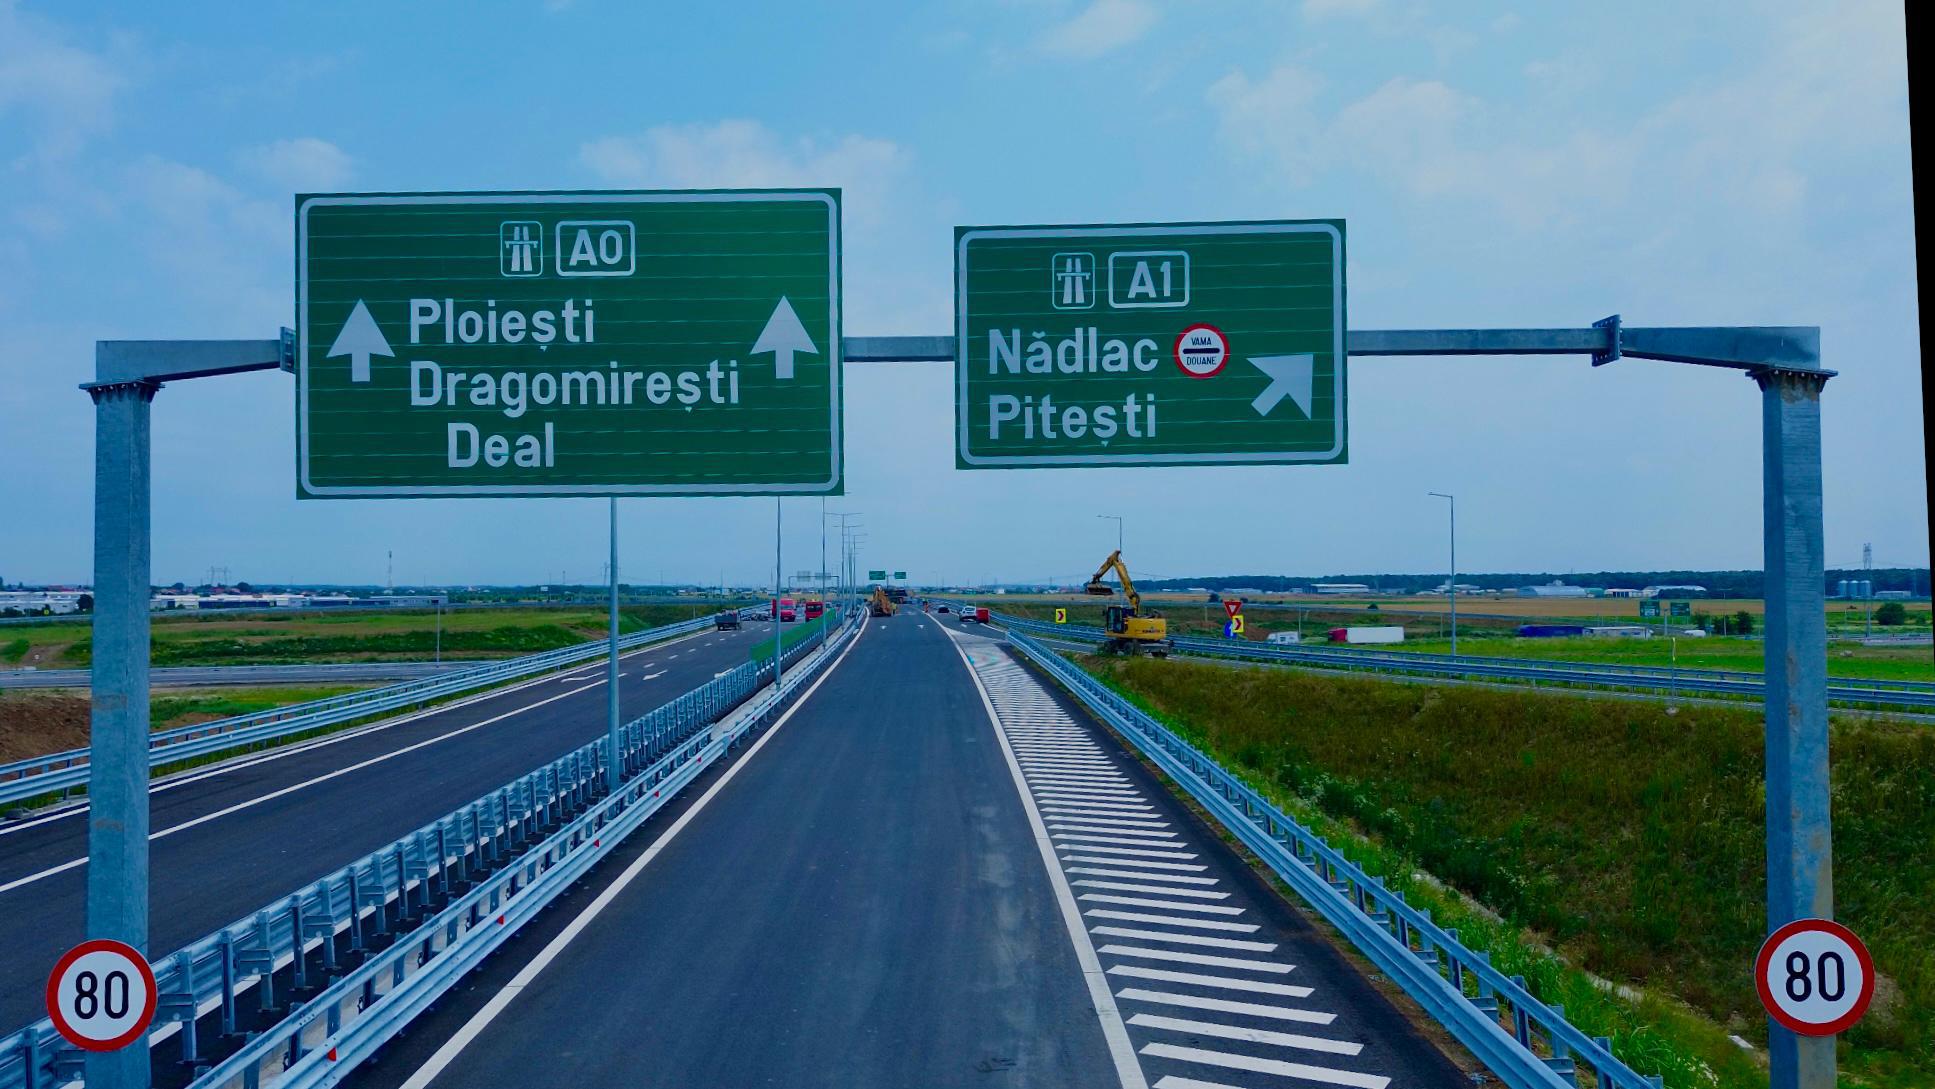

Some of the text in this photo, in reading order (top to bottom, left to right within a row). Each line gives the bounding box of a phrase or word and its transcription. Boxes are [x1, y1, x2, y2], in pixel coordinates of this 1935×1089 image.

[569, 229, 623, 266] A0
[1127, 260, 1172, 299] A1
[410, 298, 594, 352] Ploiești
[1191, 336, 1212, 346] VAMA
[988, 326, 1159, 375] Nădlac
[1186, 356, 1217, 366] DOUANE
[410, 359, 740, 418] Dragomirești
[989, 392, 1157, 447] Pitești
[447, 421, 555, 468] Deal
[74, 970, 129, 1020] 80
[1785, 950, 1846, 1003] 80
